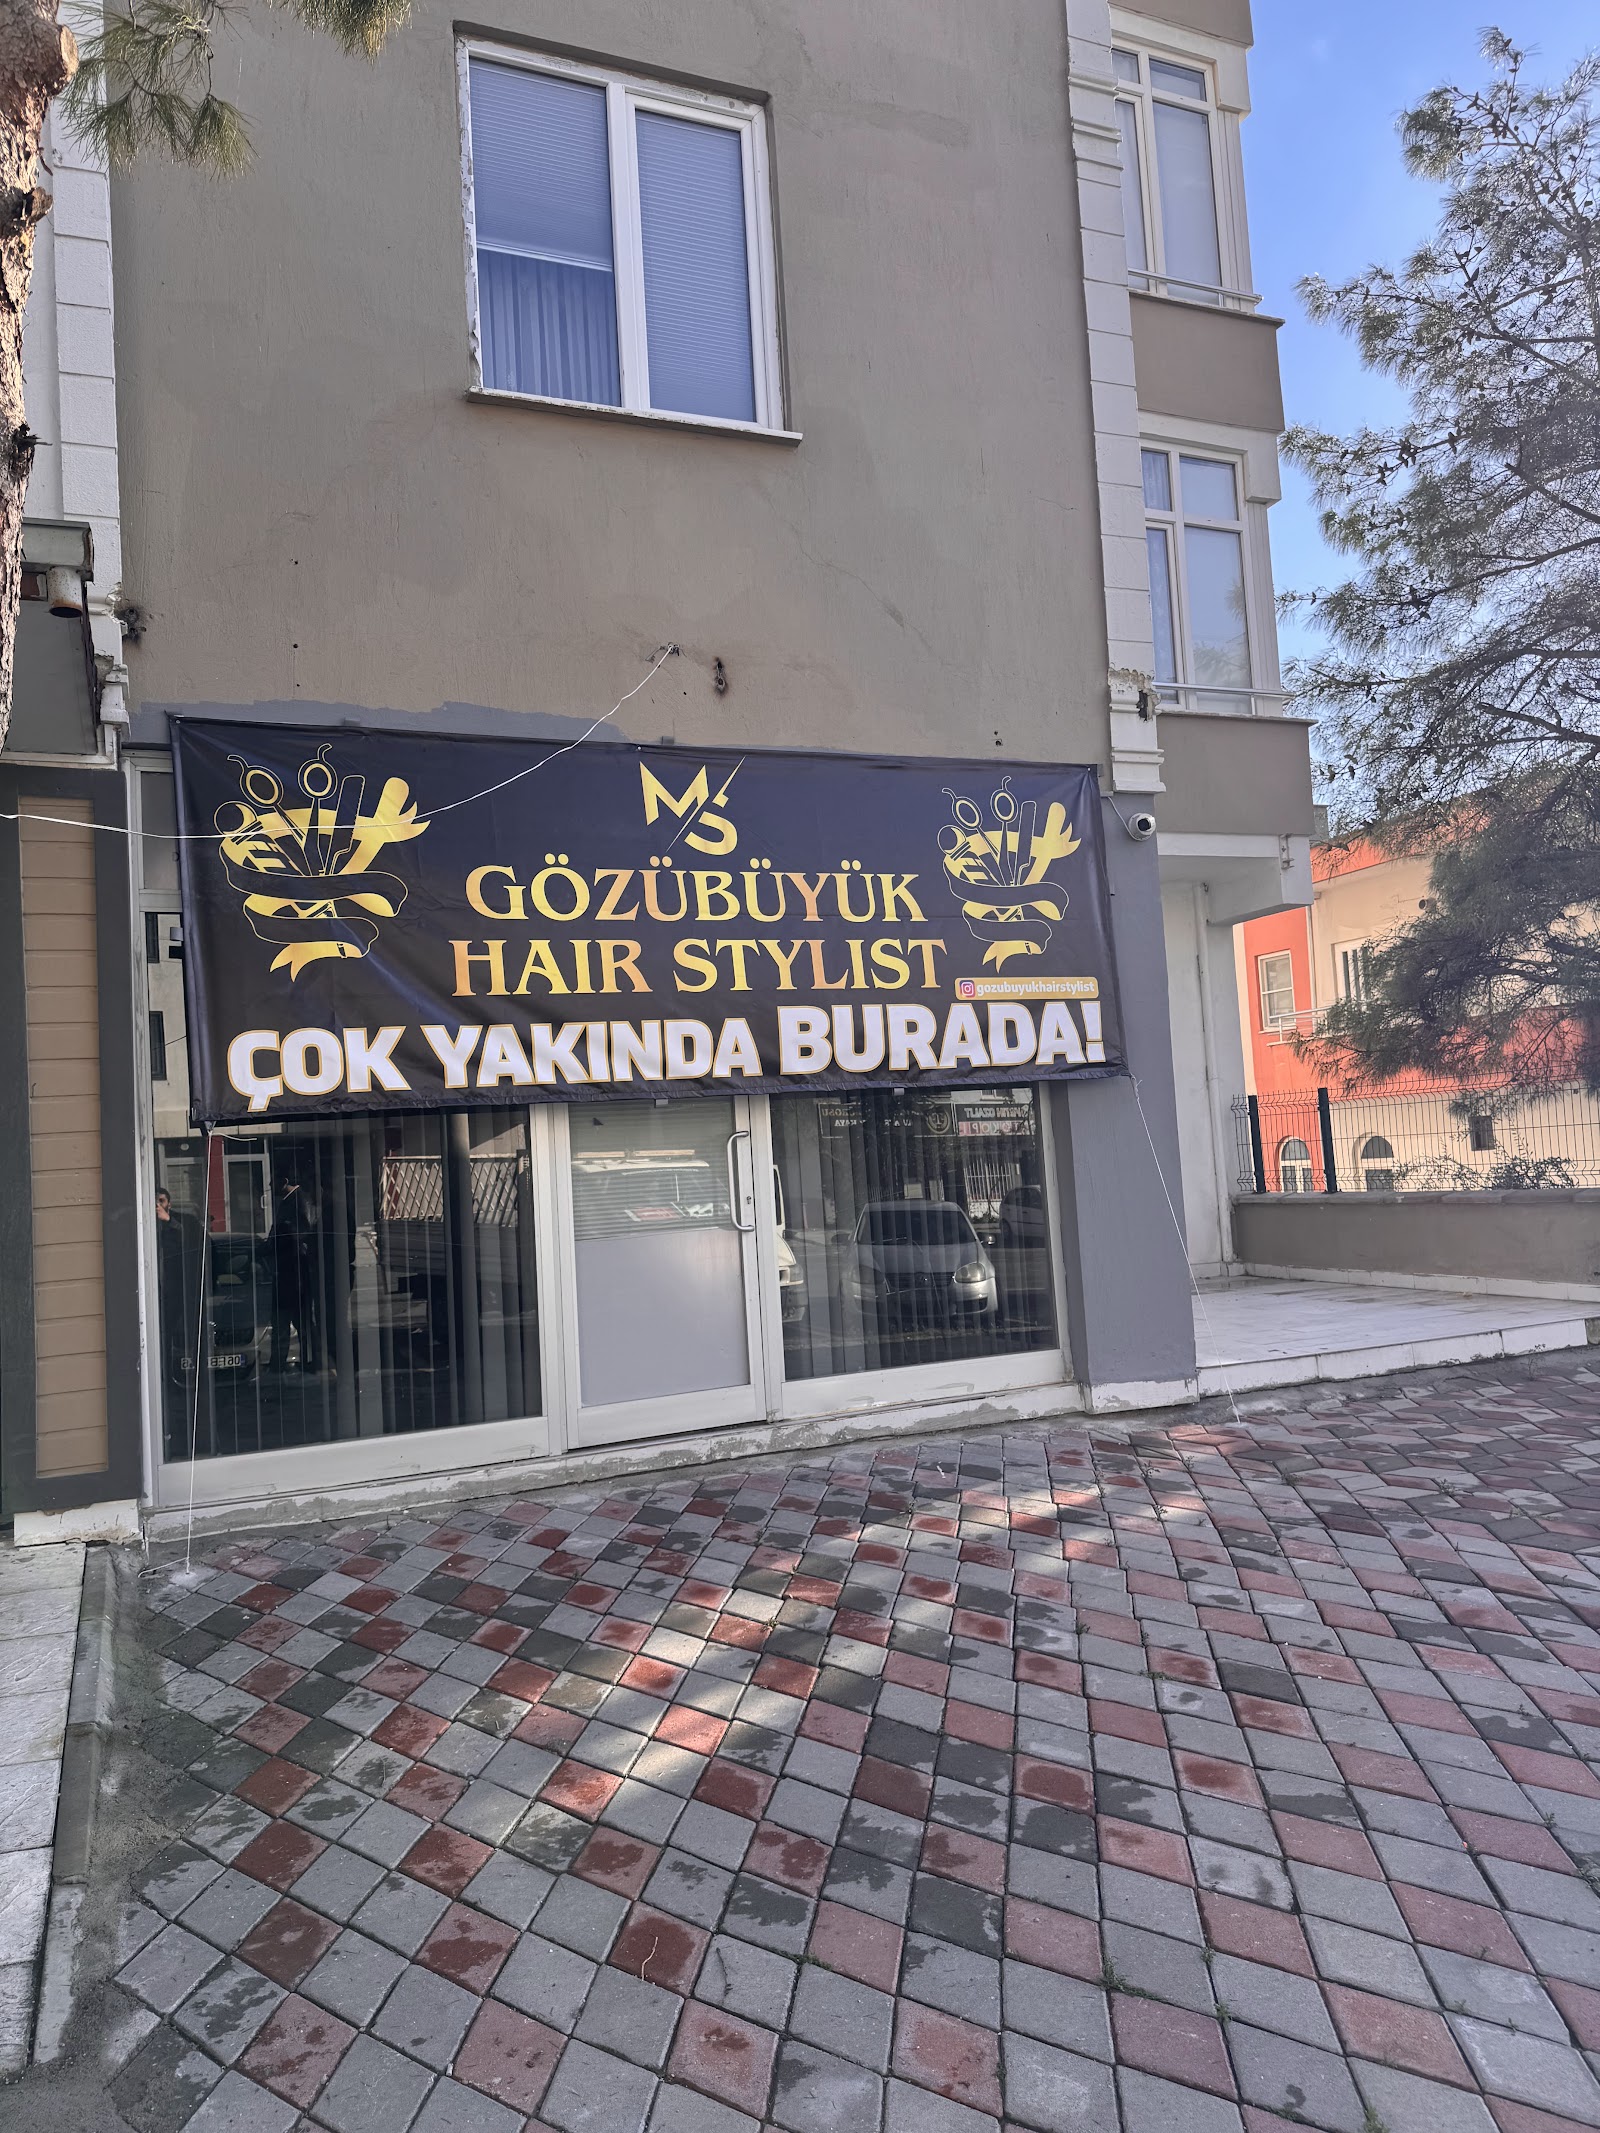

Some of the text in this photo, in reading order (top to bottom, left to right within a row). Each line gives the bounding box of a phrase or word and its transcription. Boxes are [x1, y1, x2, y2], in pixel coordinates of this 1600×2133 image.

[465, 853, 928, 922] GÖZÜBÜYÜK
[449, 938, 947, 997] HAIR STYLIST
[976, 981, 1095, 996] gozubuyukhairstylist
[227, 1001, 1107, 1112] ÇOK YAKINDA BURADA!
